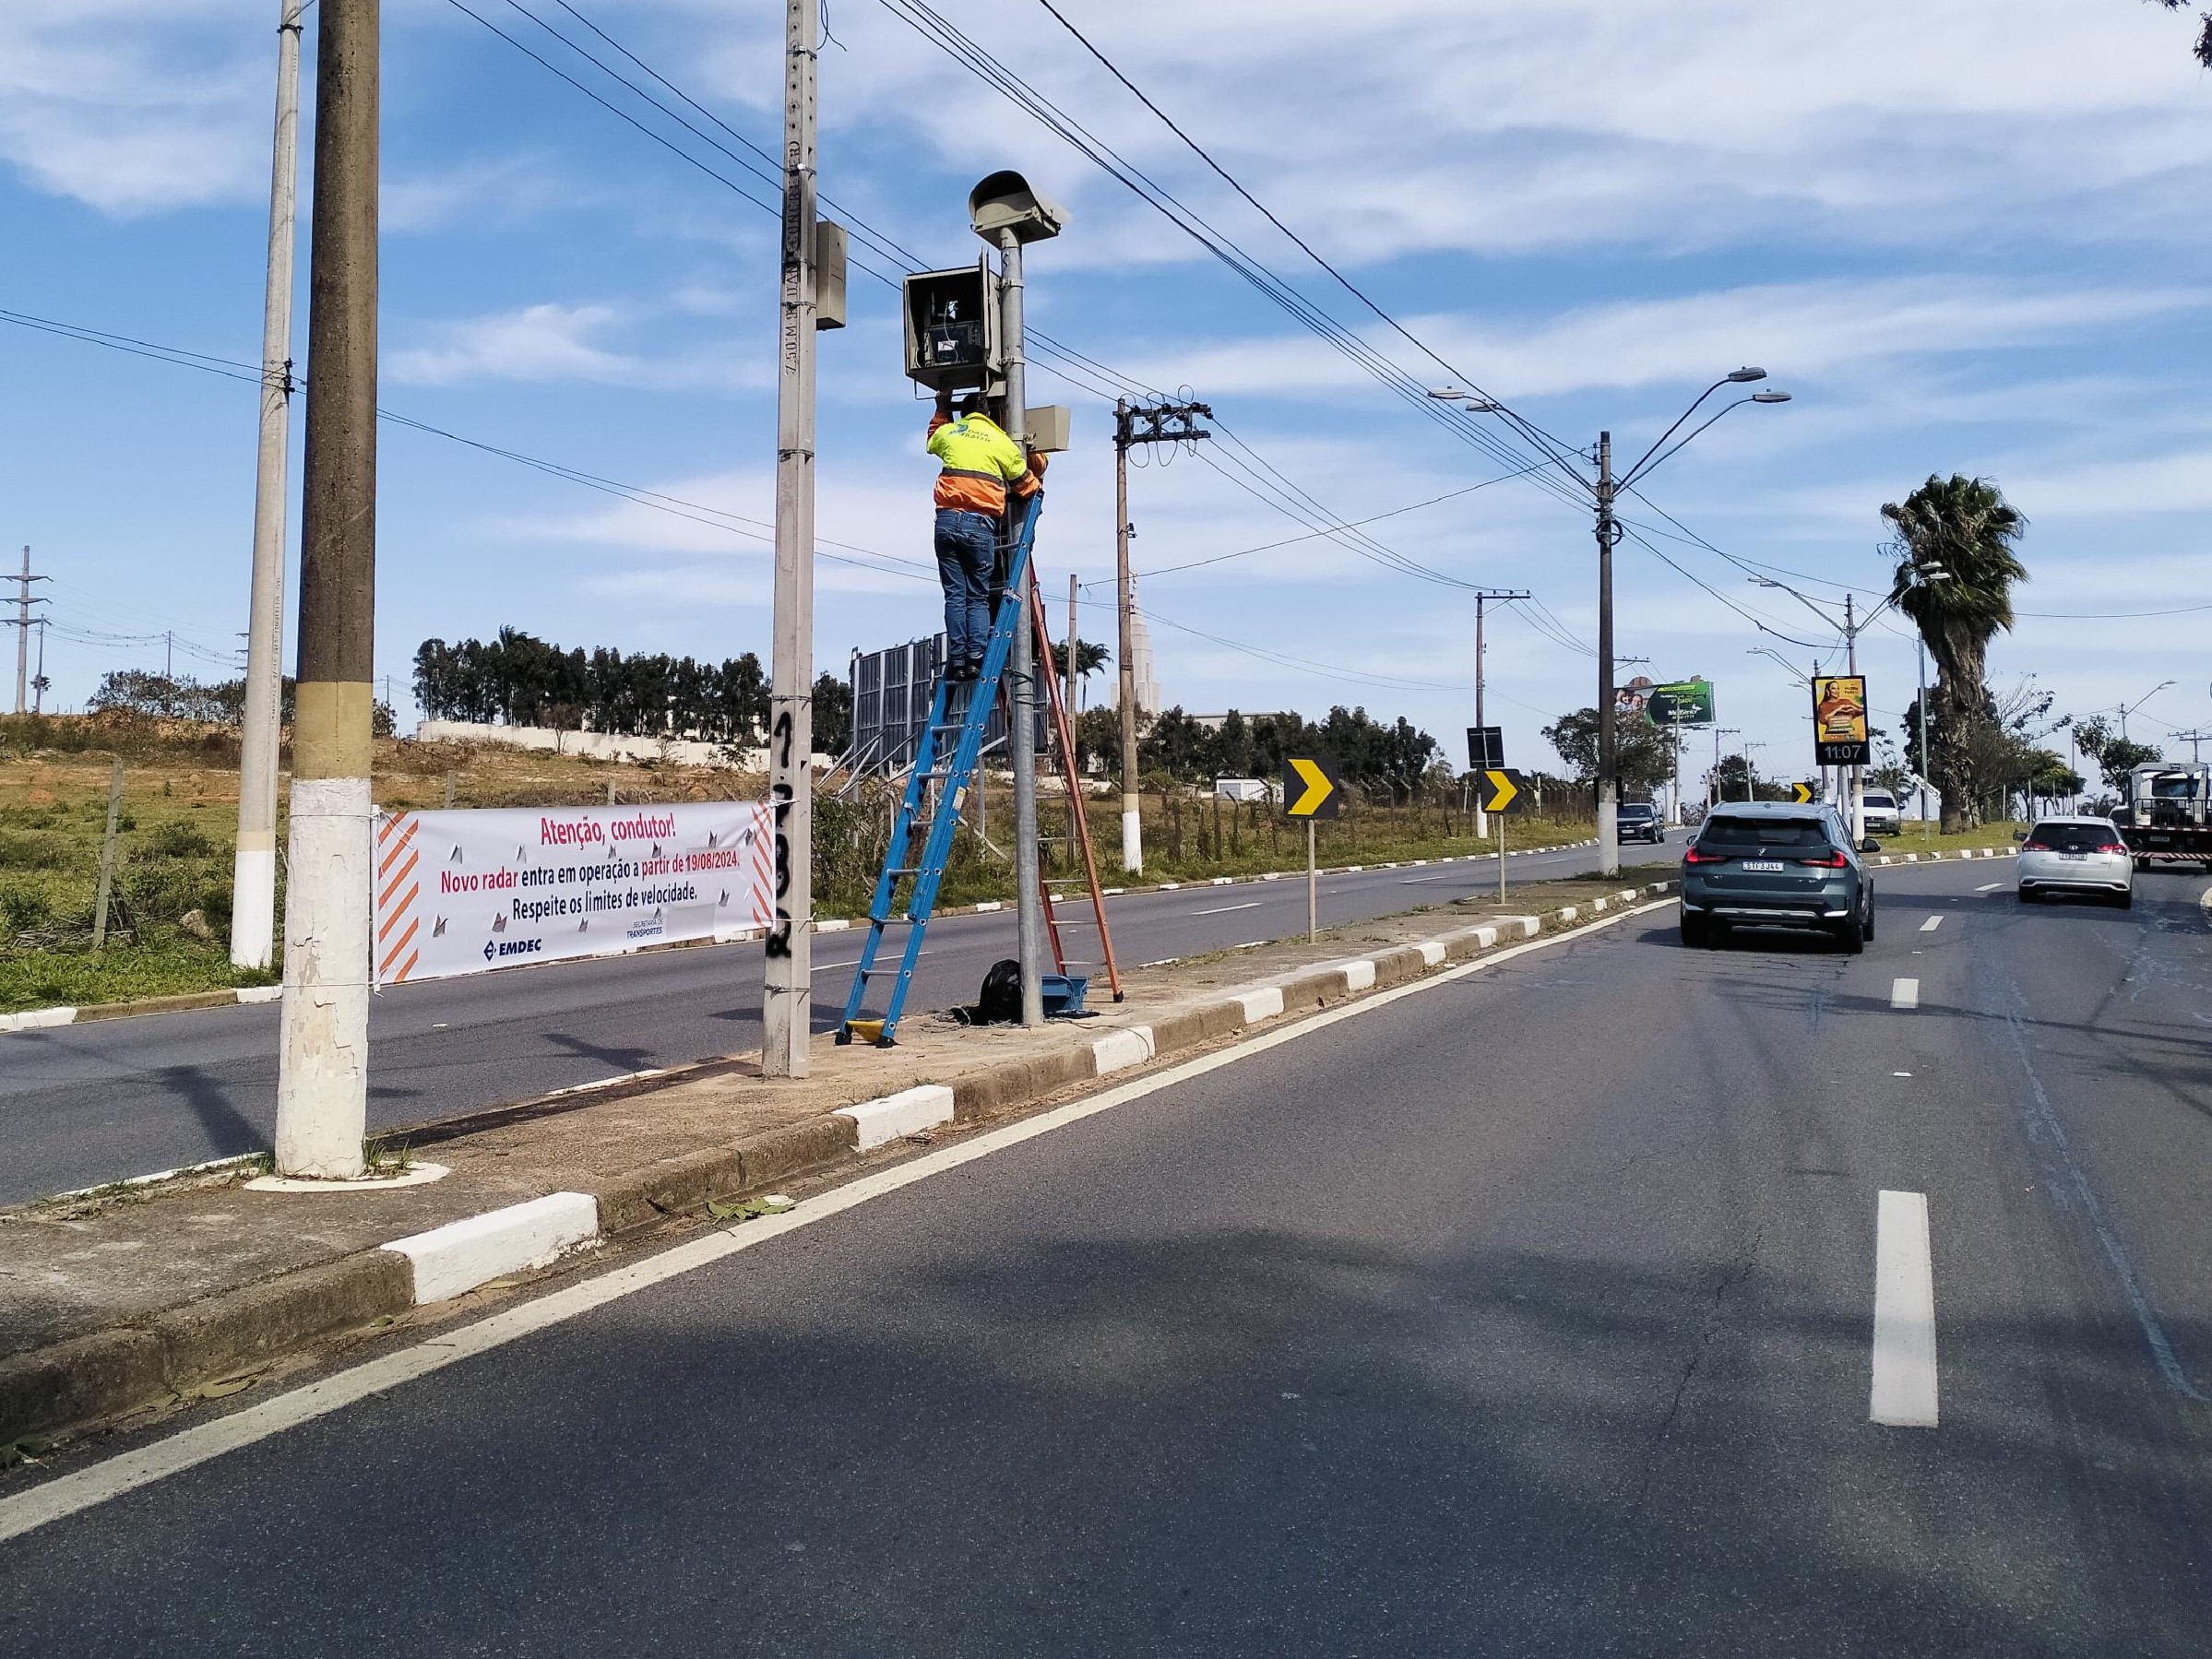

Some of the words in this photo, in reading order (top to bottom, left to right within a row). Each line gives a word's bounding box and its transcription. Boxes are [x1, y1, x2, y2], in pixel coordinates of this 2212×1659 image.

[1824, 744, 1862, 760] 11:07
[541, 815, 606, 850] Atenção,
[611, 812, 676, 842] condutor!
[441, 871, 479, 894] Novo
[482, 866, 518, 890] radar
[521, 866, 554, 887] entra
[558, 866, 577, 883] em
[579, 859, 631, 887] operação
[633, 862, 639, 875] a
[641, 855, 671, 882] partir
[672, 854, 684, 872] de
[685, 850, 740, 871] 19/08/2024.
[513, 895, 566, 924] Respeite
[569, 898, 582, 914] os
[585, 890, 623, 912] limites
[625, 887, 638, 907] de
[640, 881, 697, 906] velocidade.
[626, 926, 662, 939] TRANSPORTES
[498, 938, 542, 956] EMDEC
